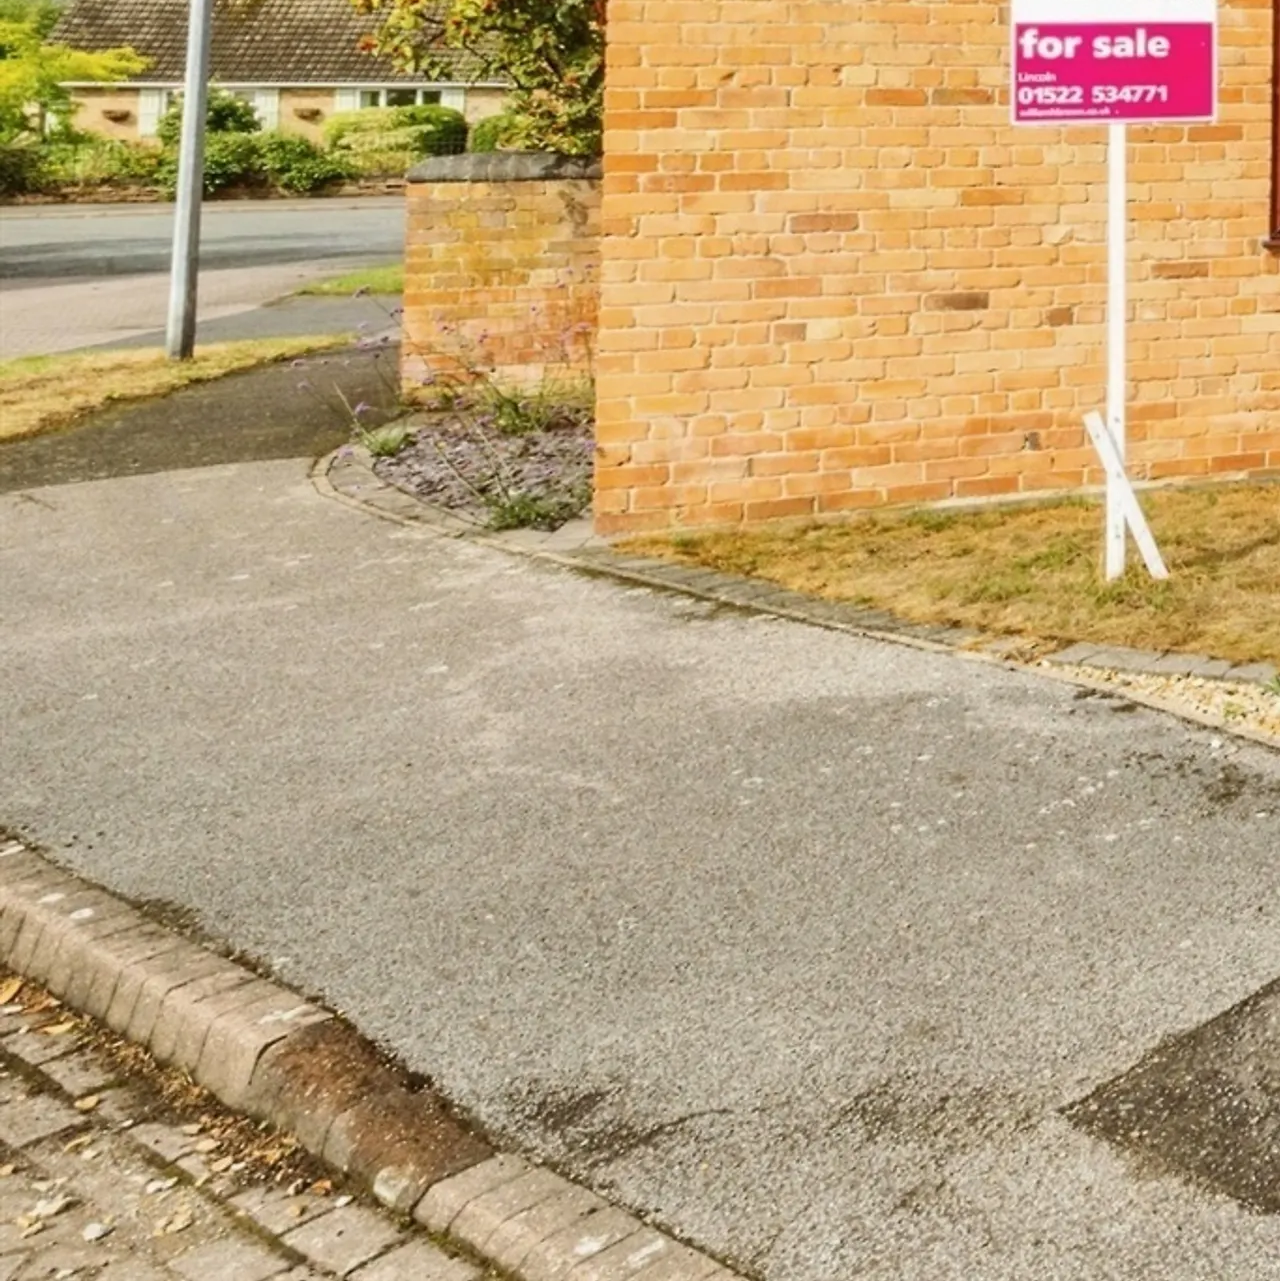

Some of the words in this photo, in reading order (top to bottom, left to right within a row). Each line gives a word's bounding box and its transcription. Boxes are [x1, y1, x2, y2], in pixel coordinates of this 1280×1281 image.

[1018, 27, 1082, 59] for
[1092, 28, 1170, 58] sale
[1018, 72, 1057, 82] Lincoln
[1018, 86, 1083, 104] 01522
[1091, 85, 1168, 102] 534771
